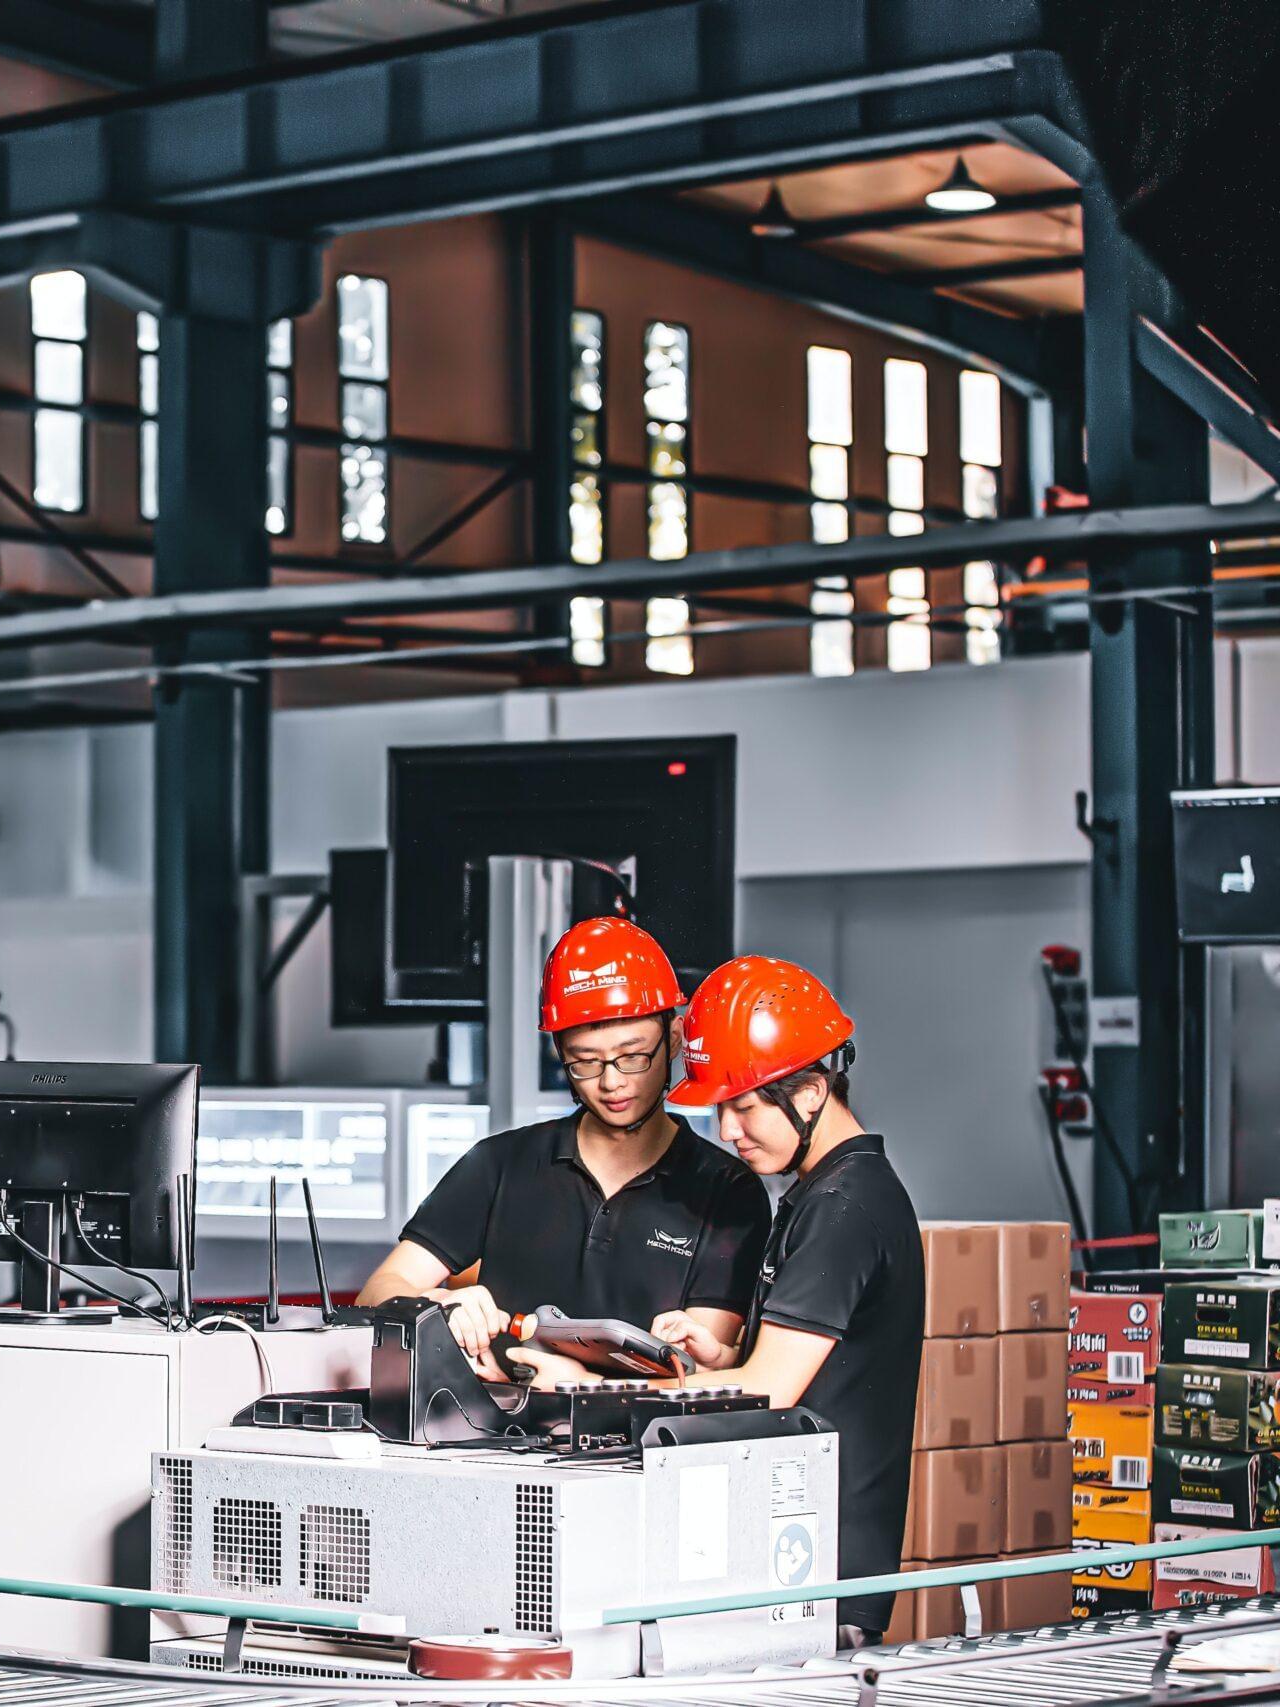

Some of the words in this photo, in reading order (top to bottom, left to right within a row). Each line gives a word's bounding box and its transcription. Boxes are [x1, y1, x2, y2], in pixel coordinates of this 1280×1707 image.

[564, 980, 595, 994] MECH
[598, 975, 627, 986] MIND
[690, 1053, 710, 1062] MIND
[30, 1074, 67, 1084] PHILIPS
[647, 1239, 671, 1251] MECH
[670, 1245, 692, 1257] MIND
[1197, 1325, 1238, 1335] ORANGE
[1181, 1485, 1221, 1495] ORANGE
